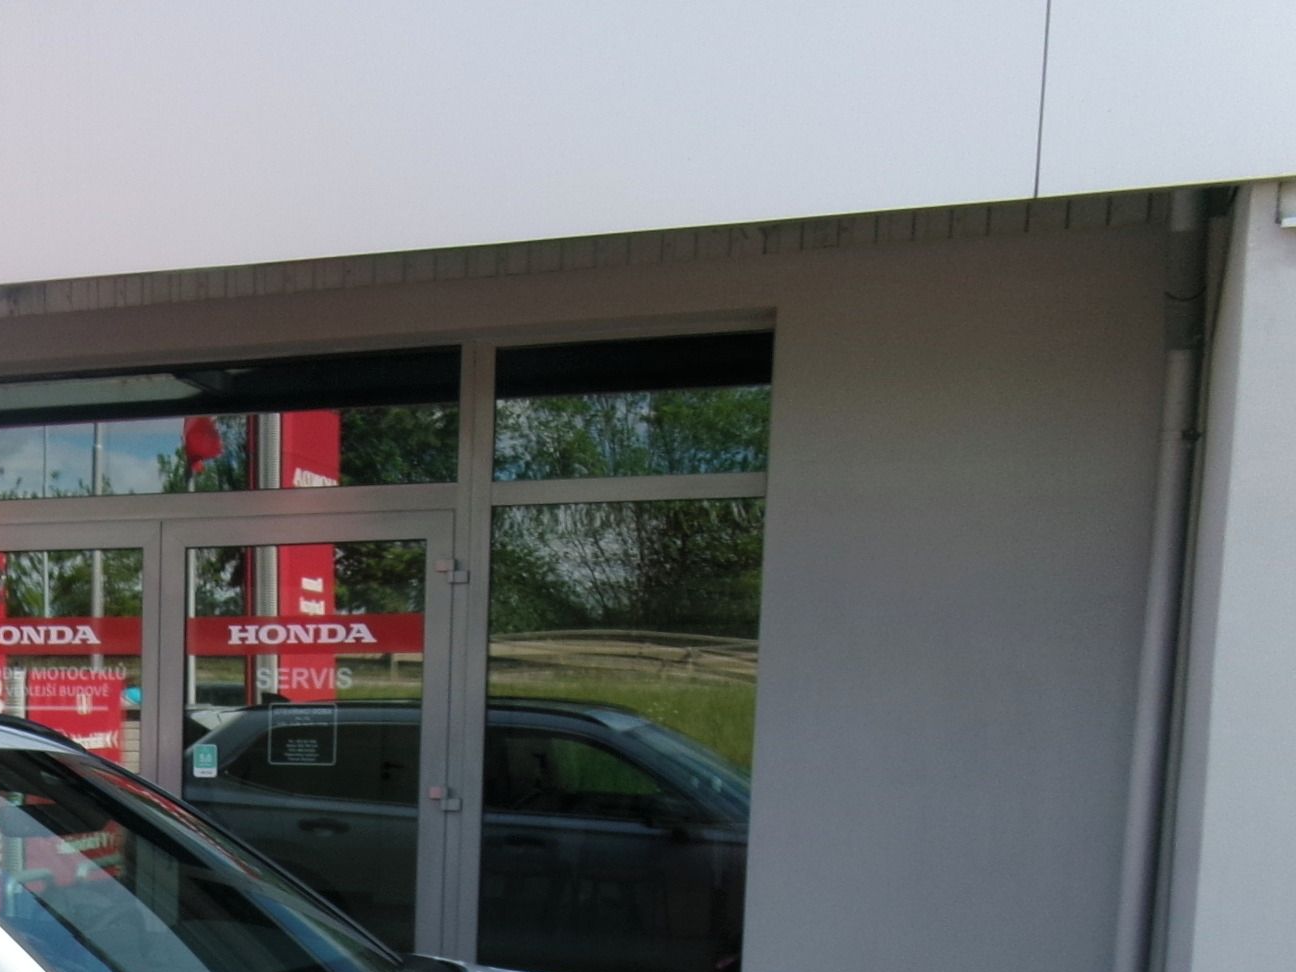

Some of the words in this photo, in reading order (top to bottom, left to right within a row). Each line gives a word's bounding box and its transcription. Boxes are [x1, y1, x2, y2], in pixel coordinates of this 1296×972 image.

[228, 623, 377, 645] HONDA
[31, 662, 127, 681] MOTOCYKLŮ
[256, 667, 353, 690] SERVIS
